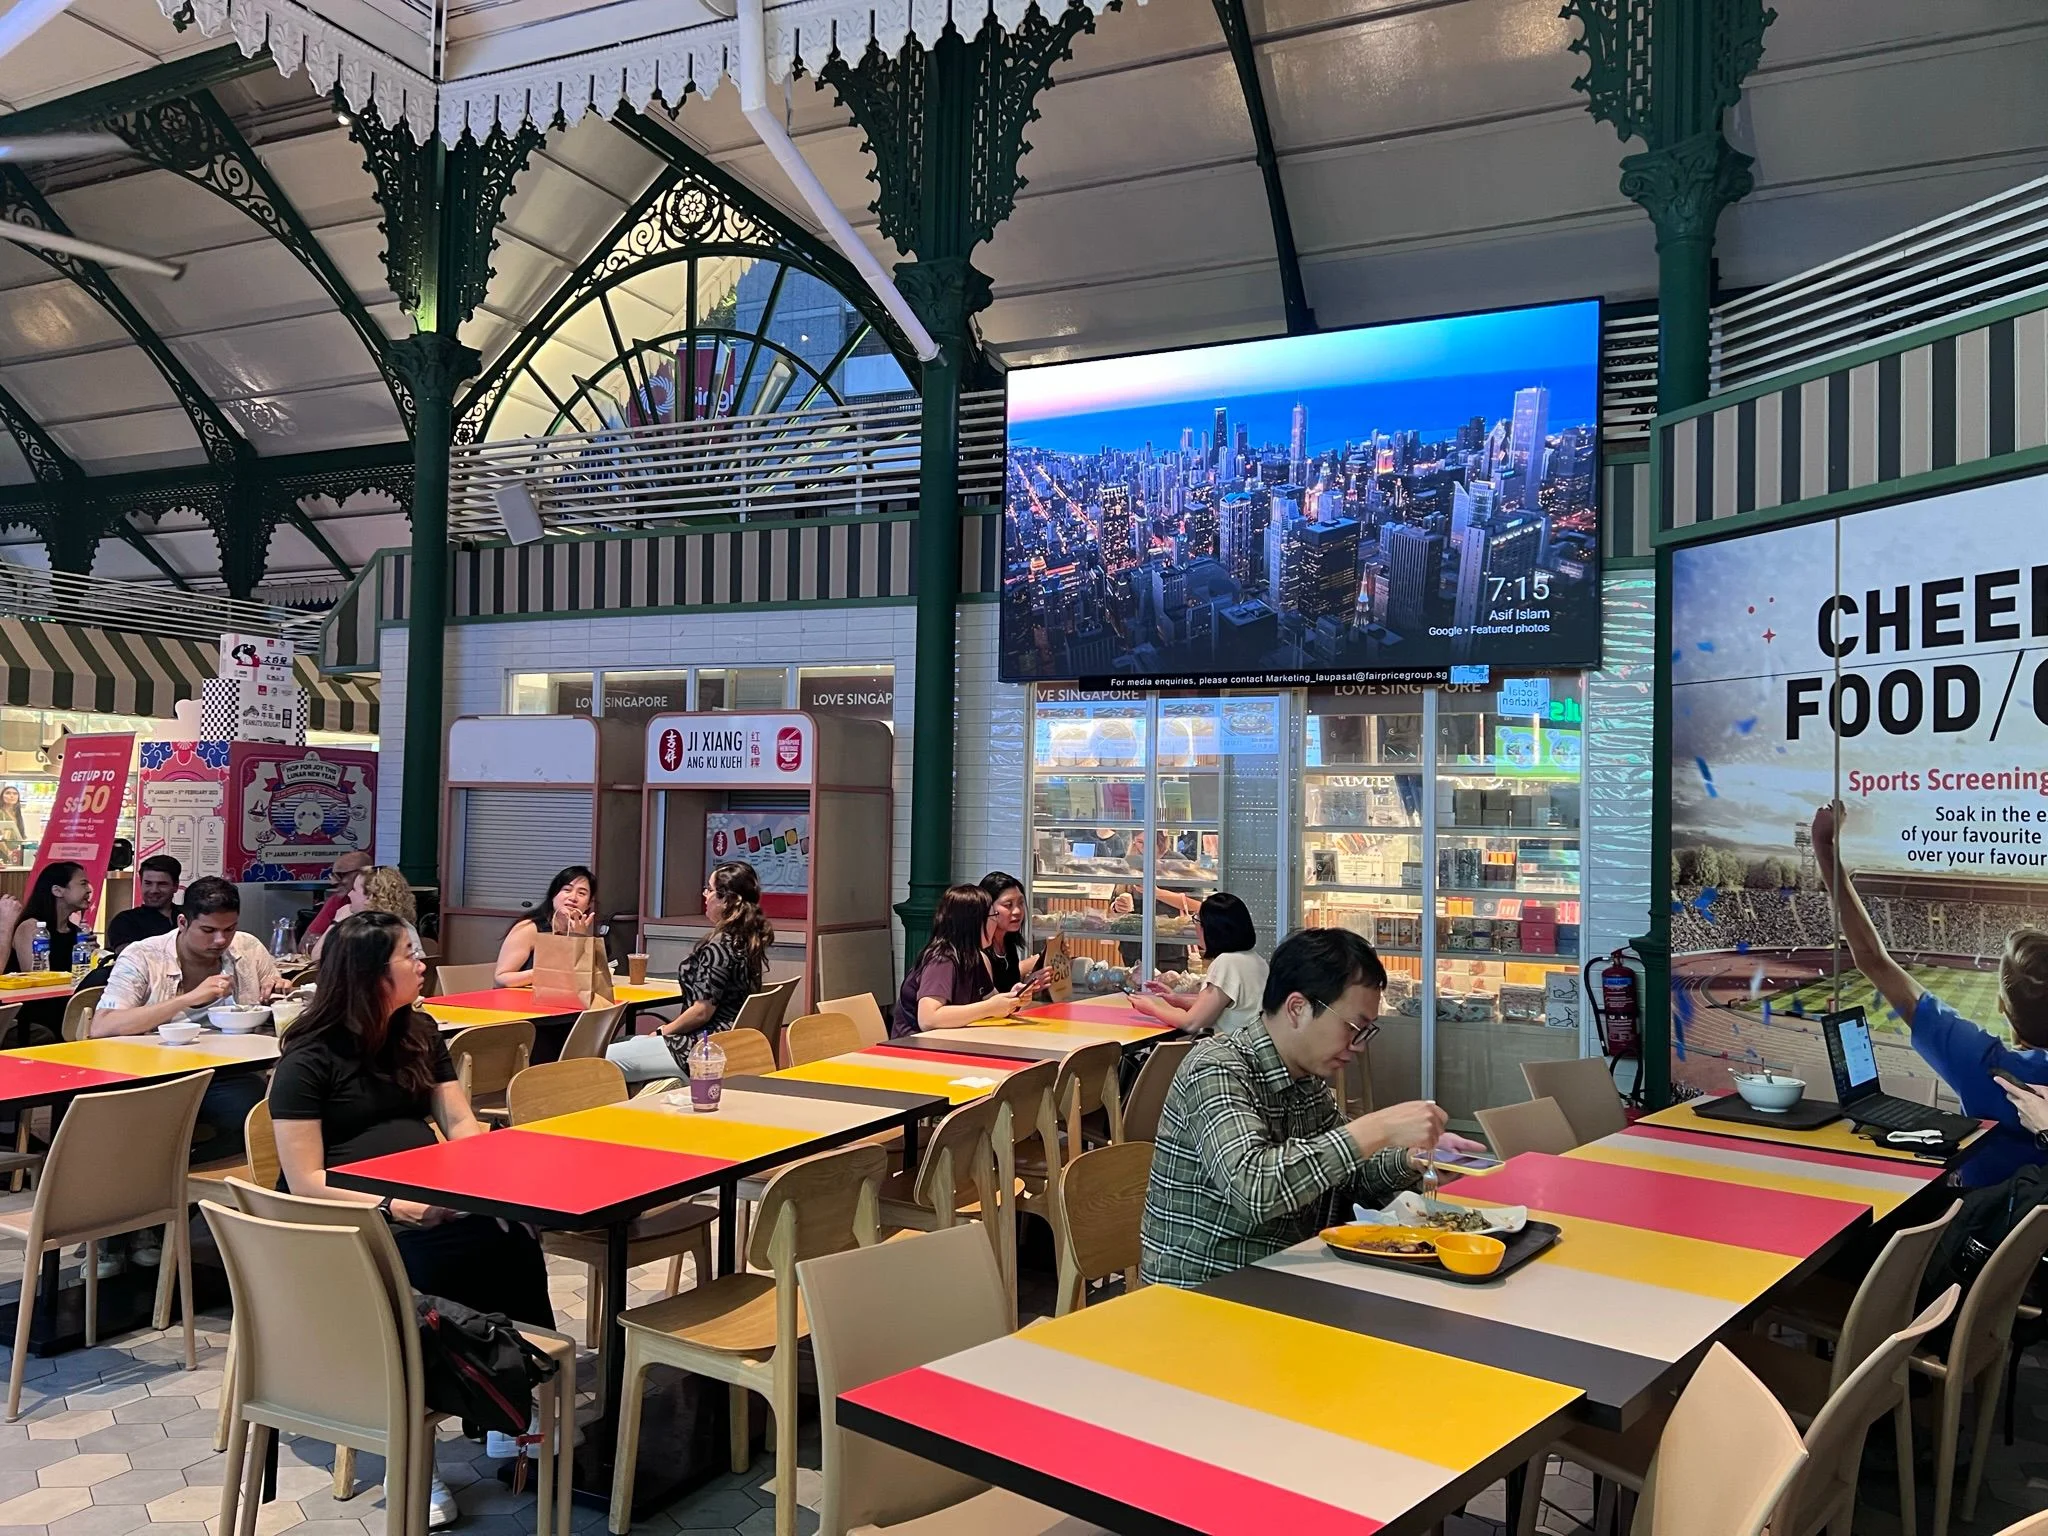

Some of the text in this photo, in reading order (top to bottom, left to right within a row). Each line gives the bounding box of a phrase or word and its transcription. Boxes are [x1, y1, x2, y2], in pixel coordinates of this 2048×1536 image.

[1488, 575, 1550, 602] 7:15
[1489, 608, 1550, 621] Asif Islam
[1428, 623, 1550, 637] Google Featured photos
[1111, 671, 1448, 687] For media enquiries, please contact Marketing_laupasat@fairpricegroup.sg
[605, 696, 668, 708] SINGAPORE
[813, 693, 844, 706] LOVE
[687, 731, 743, 752] JI XIANG
[687, 755, 742, 769] ANG KU KUEH
[101, 770, 115, 782] TO
[1848, 770, 1921, 797] Sports
[1935, 805, 1976, 822] Soak
[1981, 806, 1997, 822] in
[2002, 805, 2031, 823] the
[1901, 825, 2042, 845] of your favourite
[1907, 850, 1943, 862] over
[1947, 851, 1985, 866] your
